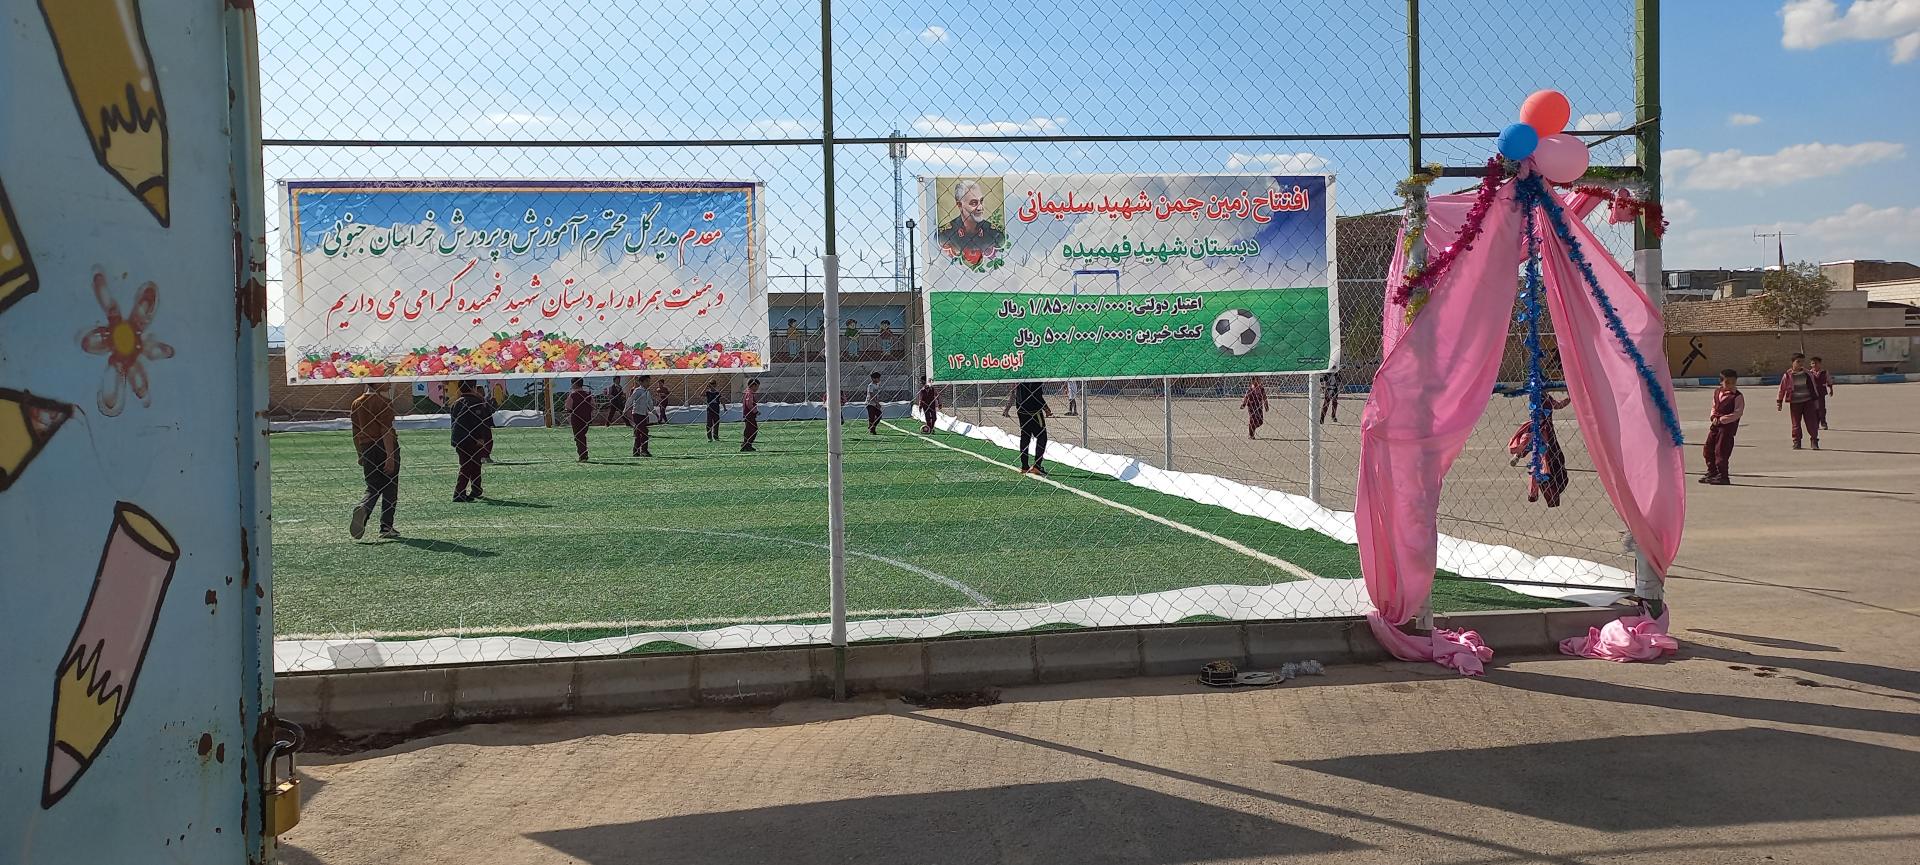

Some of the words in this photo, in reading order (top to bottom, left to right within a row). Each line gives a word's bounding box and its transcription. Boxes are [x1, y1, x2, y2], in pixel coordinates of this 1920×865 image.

[1018, 190, 1094, 223] سلیمانی
[1097, 190, 1153, 221] شهید
[1155, 194, 1204, 221] چمن
[1206, 190, 1250, 220] زمین
[1252, 185, 1309, 223] افتتاح
[323, 212, 367, 259] جنوبی
[369, 210, 436, 257] خراسان
[509, 208, 588, 255] آموزش
[580, 209, 628, 268] محترم
[624, 202, 661, 255] کل
[650, 227, 679, 260] مدیر
[678, 211, 722, 268] مقدم
[1062, 234, 1133, 264] فهمیده
[1134, 236, 1188, 263] شهید
[1189, 235, 1260, 262] دبستان
[403, 257, 478, 321] گرامی
[457, 271, 502, 325] فهمیده
[502, 273, 542, 324] شهید
[541, 278, 594, 322] دبستان
[627, 287, 662, 317] همراه
[715, 290, 726, 307] و
[998, 299, 1025, 318] ریال
[1171, 296, 1203, 315] اعتبار
[1014, 328, 1041, 347] ریال
[1173, 324, 1203, 341] کمک
[948, 353, 980, 370] ۱۴۰۱
[981, 355, 1000, 369] ماه
[1000, 350, 1024, 371] آبان
